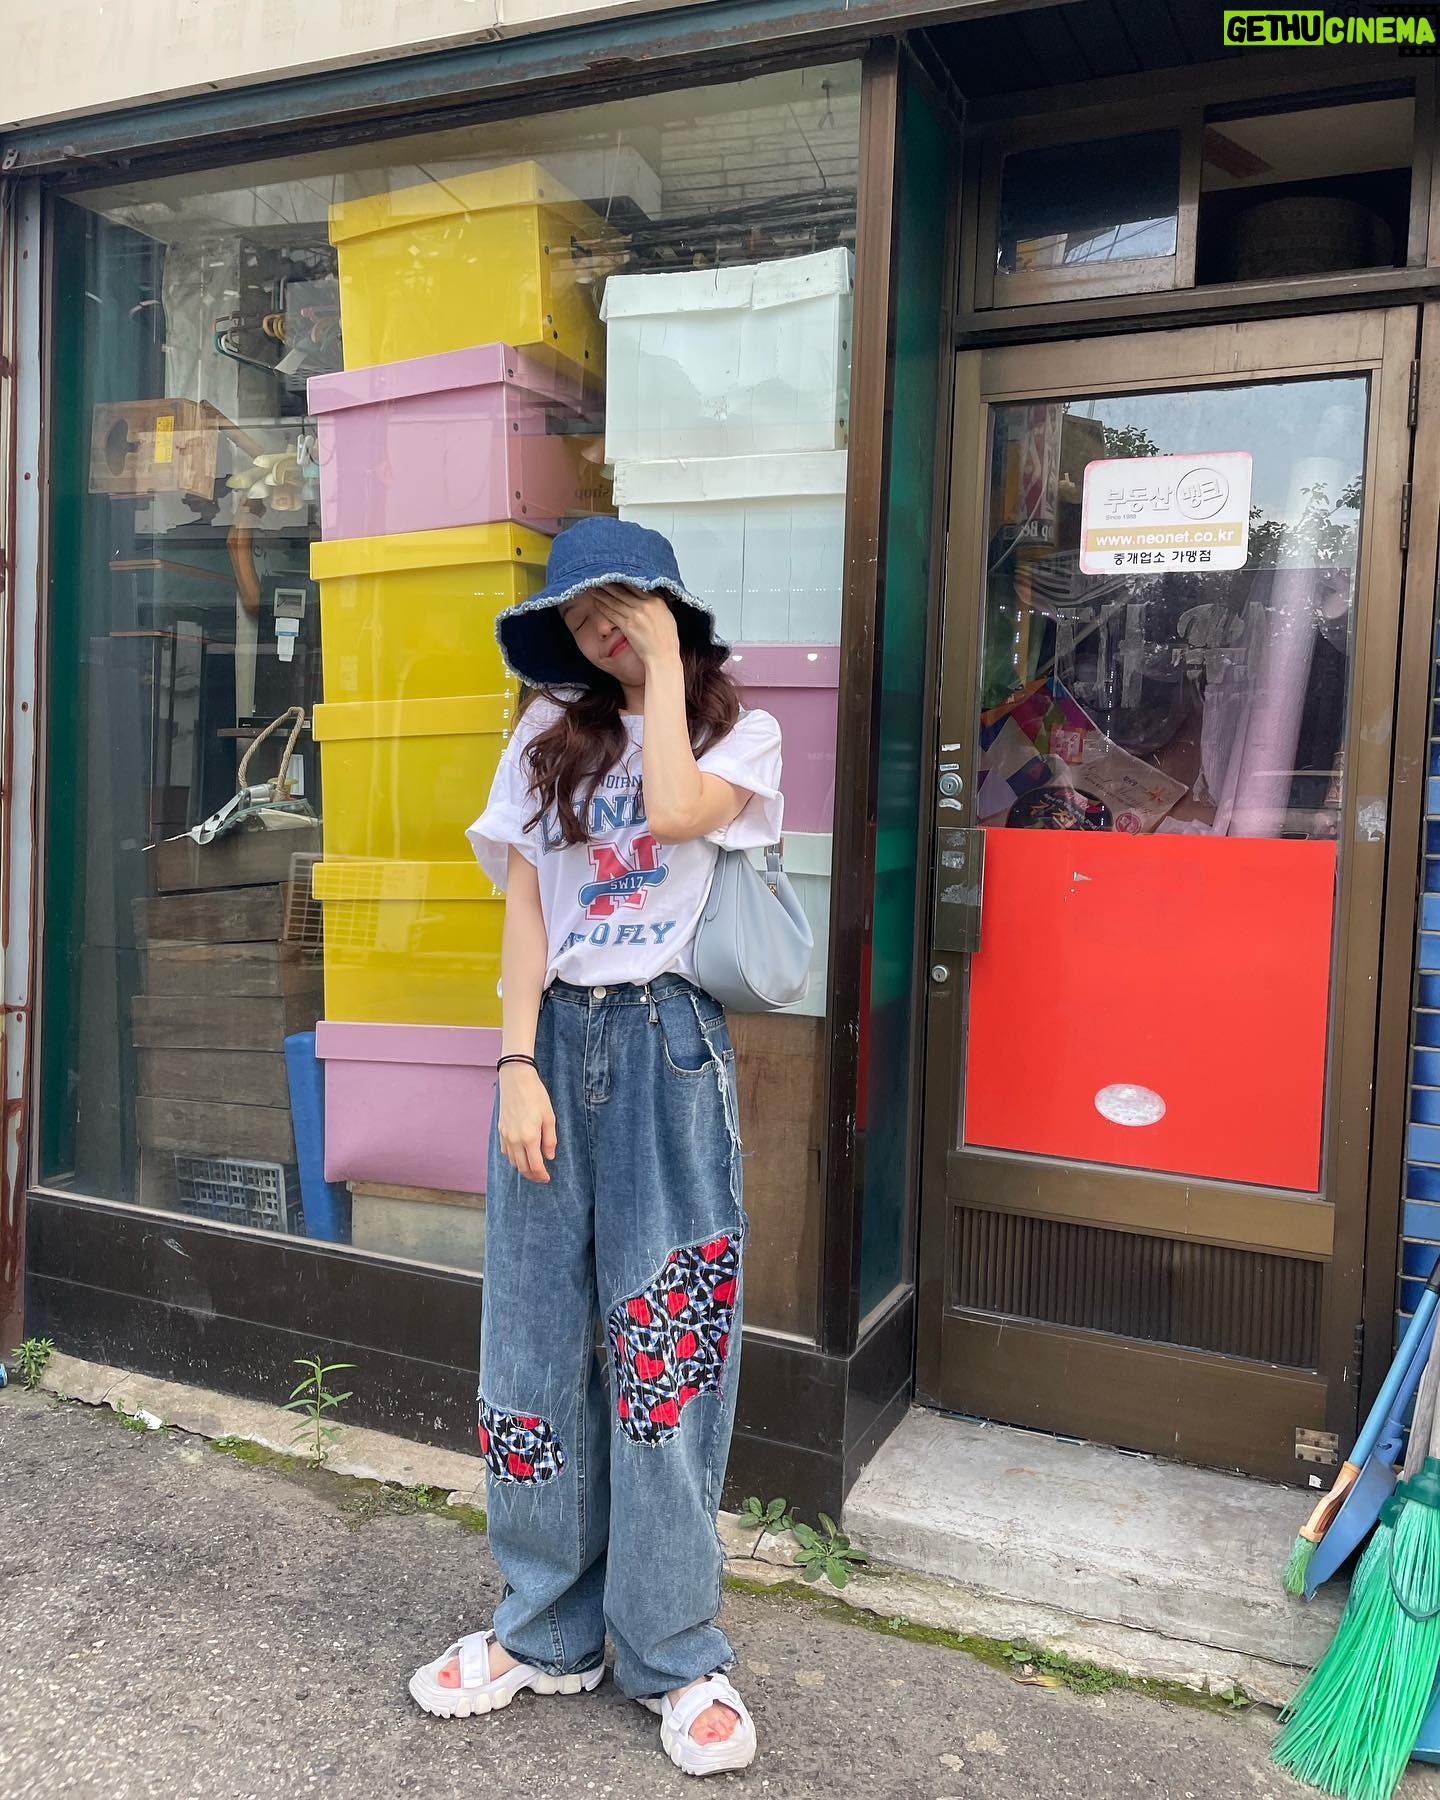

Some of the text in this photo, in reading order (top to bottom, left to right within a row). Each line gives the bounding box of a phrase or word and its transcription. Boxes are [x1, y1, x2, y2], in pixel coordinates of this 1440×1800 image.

[1104, 486, 1174, 513] 부동산
[1096, 529, 1234, 546] www.neonet.co.kr
[1113, 550, 1212, 565] 중개업소 가맹점
[610, 876, 644, 890] SW17
[613, 920, 677, 946] FLY
